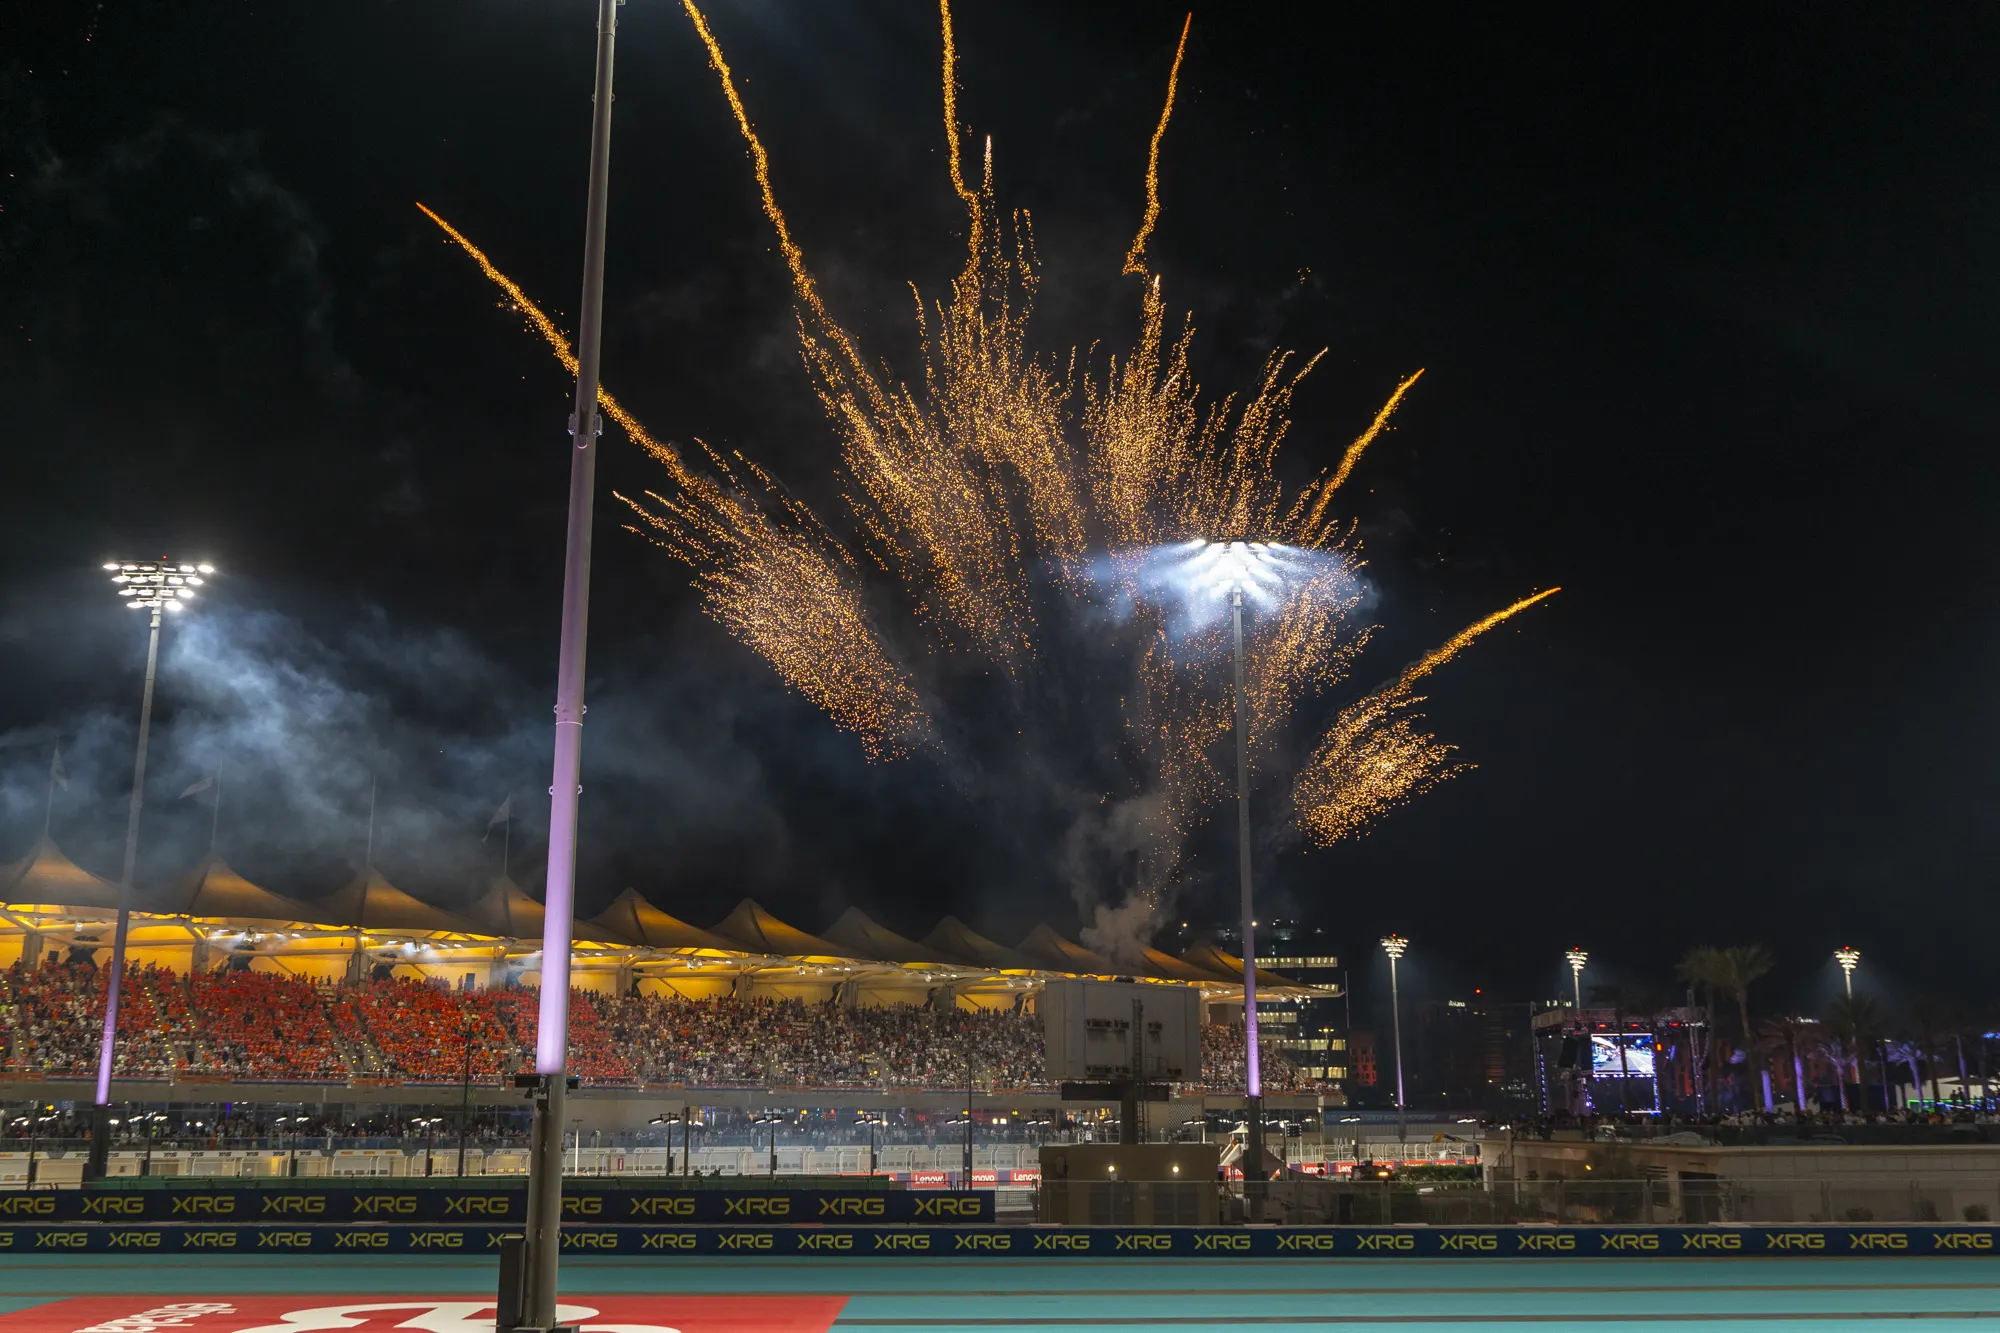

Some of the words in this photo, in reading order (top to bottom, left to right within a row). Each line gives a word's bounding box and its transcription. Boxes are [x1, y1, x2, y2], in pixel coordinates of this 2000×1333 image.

[82, 1197, 144, 1214] XRG
[172, 1197, 235, 1213] XRG
[263, 1197, 325, 1213] XRG
[354, 1197, 417, 1213] XRG
[445, 1197, 509, 1214] XRG
[560, 1198, 602, 1214] RG
[631, 1198, 695, 1215] XRG
[725, 1197, 790, 1215] XRG
[819, 1197, 885, 1215] XRG
[915, 1197, 980, 1215] XRG
[36, 1232, 87, 1247] XRG
[110, 1232, 160, 1247] XRG
[184, 1232, 236, 1246] XRG
[259, 1232, 311, 1246] XRG
[336, 1232, 388, 1247] XRG
[411, 1232, 462, 1247] XRG
[563, 1233, 617, 1248] XRG
[643, 1234, 696, 1248] XRG
[719, 1234, 773, 1248] XRG
[799, 1234, 852, 1249] XRG
[876, 1234, 930, 1249] XRG
[956, 1234, 1010, 1249] XRG
[1035, 1235, 1089, 1249] XRG
[1116, 1235, 1170, 1249] XRG
[1195, 1235, 1250, 1250] XRG
[1277, 1235, 1333, 1249] XRG
[1358, 1235, 1414, 1249] XRG
[1441, 1235, 1497, 1249] XRG
[1519, 1234, 1575, 1249] XRG
[1602, 1234, 1658, 1249] XRG
[1684, 1234, 1741, 1248] XRG
[1768, 1233, 1825, 1248] XRG
[1850, 1233, 1908, 1248] XRG
[1934, 1233, 1992, 1248] XRG
